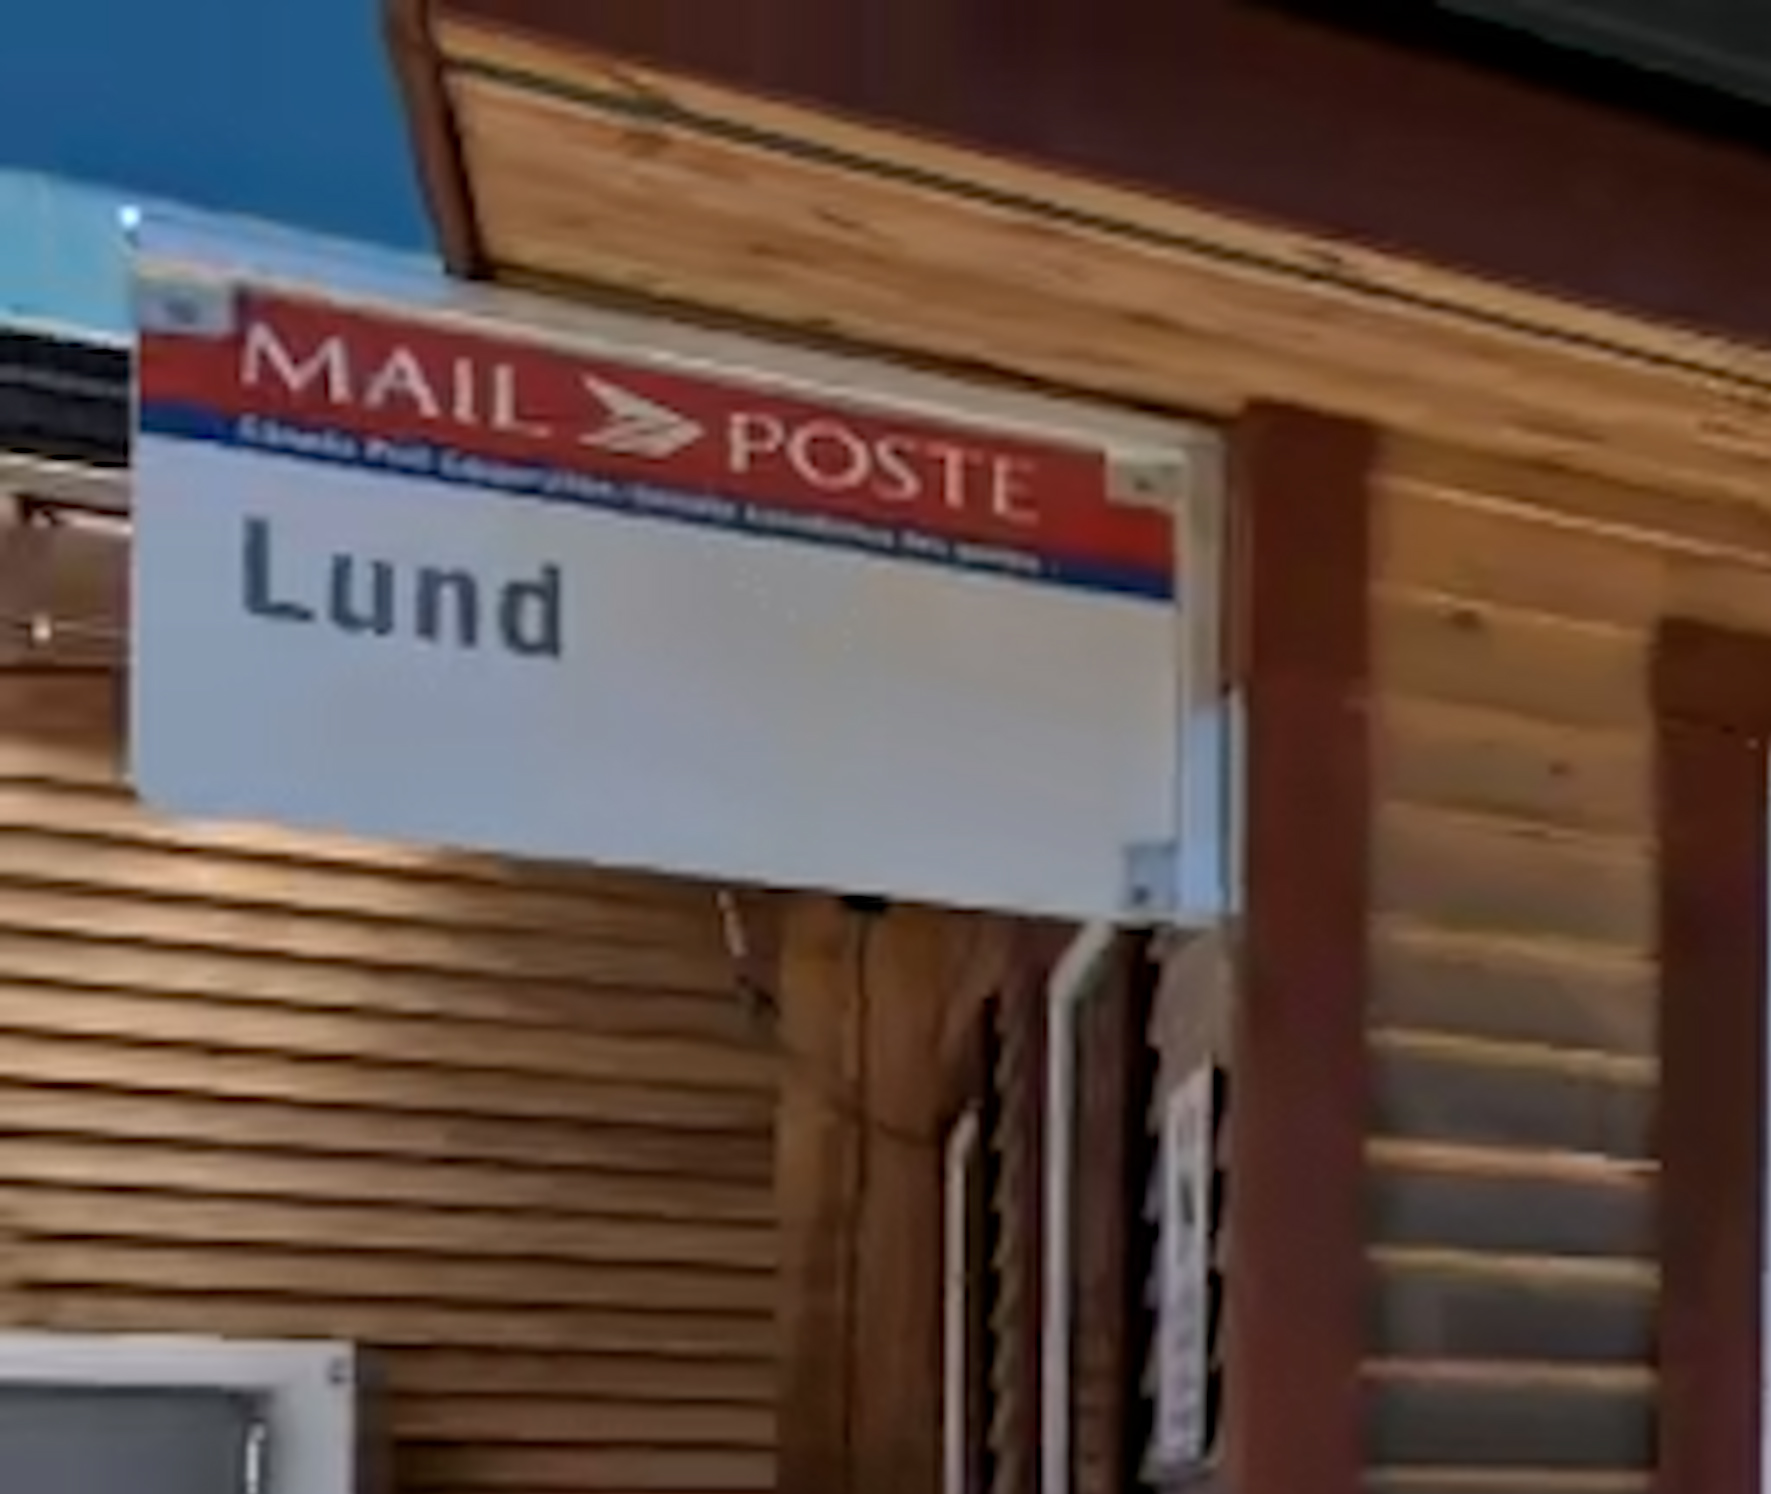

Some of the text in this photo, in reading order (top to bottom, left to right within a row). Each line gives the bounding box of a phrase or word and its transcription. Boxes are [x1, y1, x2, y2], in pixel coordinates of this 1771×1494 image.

[240, 322, 551, 441] MAIL
[726, 410, 1040, 525] POSTE
[240, 516, 564, 660] Lund
